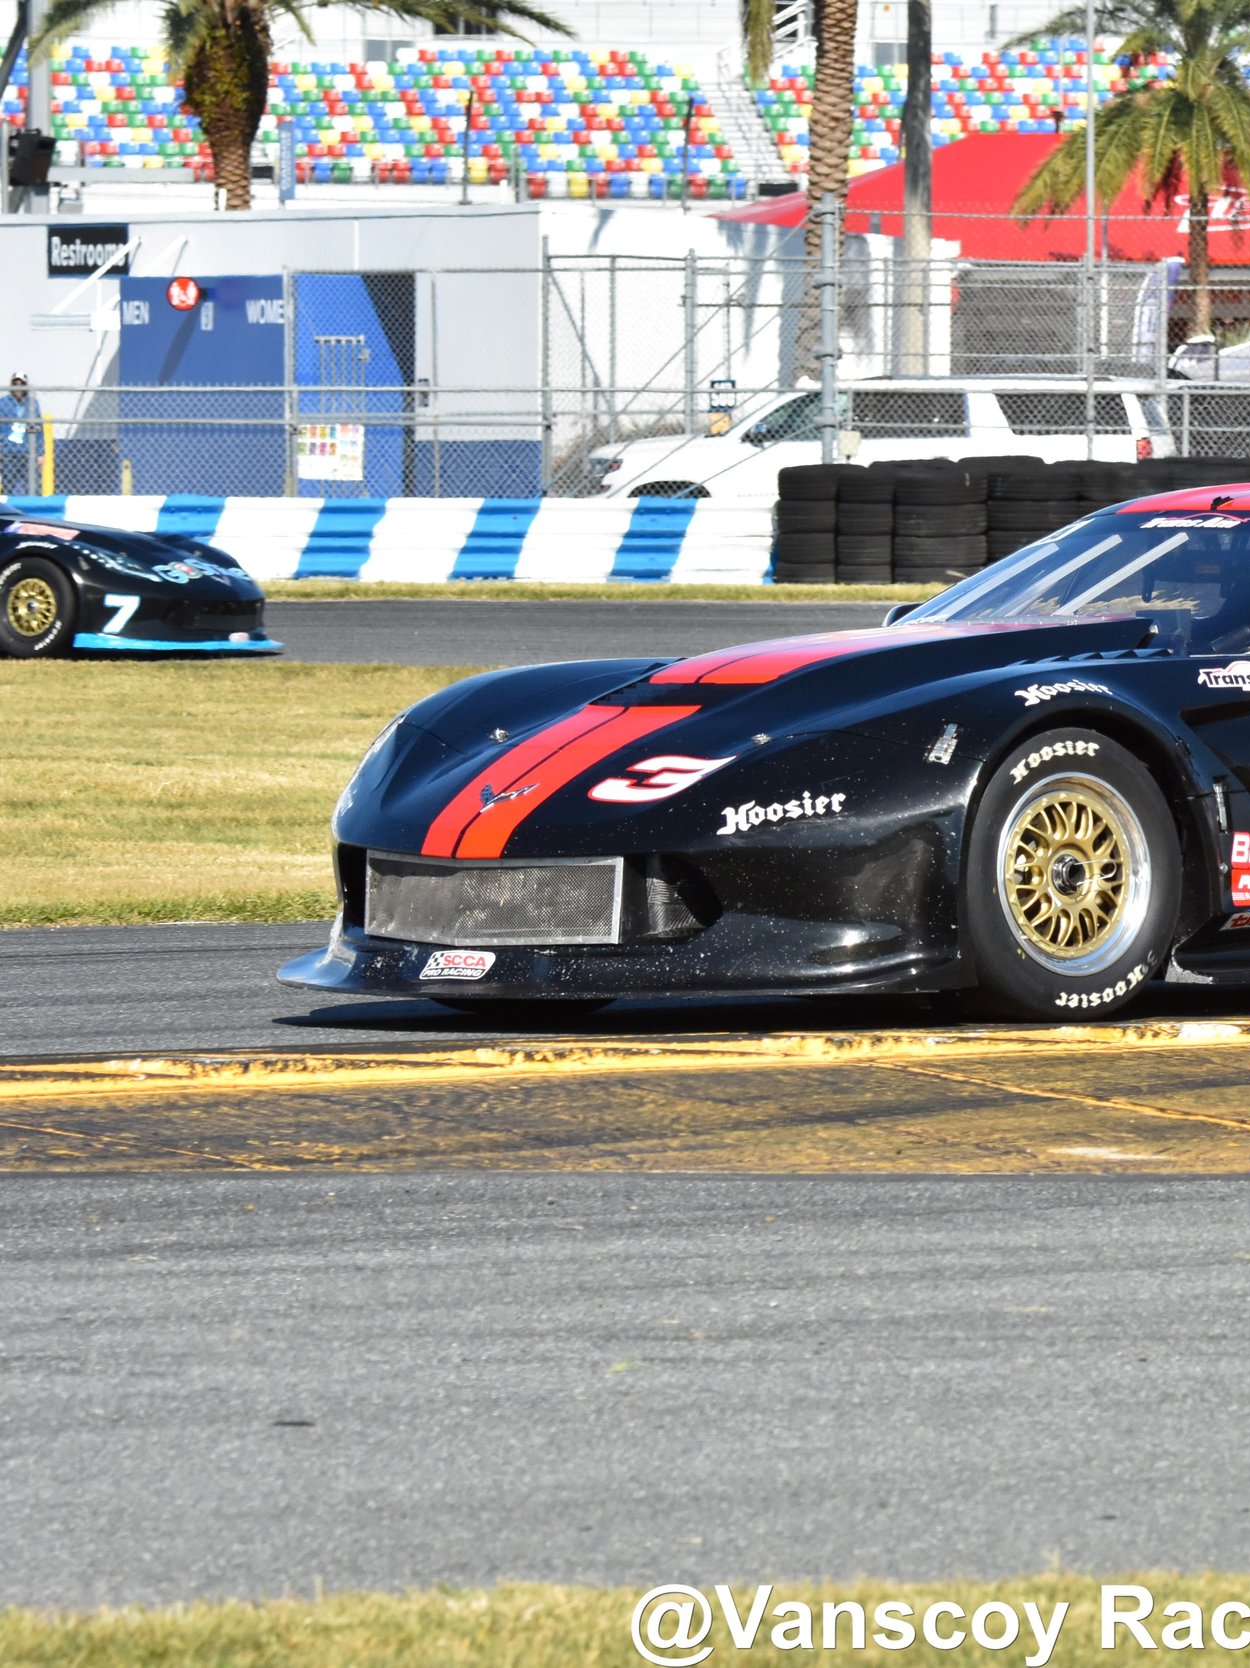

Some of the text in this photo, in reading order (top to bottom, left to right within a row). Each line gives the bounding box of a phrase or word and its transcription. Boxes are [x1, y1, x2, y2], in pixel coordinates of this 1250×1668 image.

[50, 236, 126, 266] Restrooms
[122, 301, 149, 324] MEN
[246, 299, 287, 324] WOME
[103, 594, 140, 633] 7
[1014, 679, 1113, 707] Hoosier
[1009, 740, 1100, 785] Hoosier
[587, 755, 738, 804] 3
[716, 791, 847, 836] Hoosier
[422, 968, 483, 977] PRO RACING
[443, 955, 487, 968] SCCA
[1055, 964, 1145, 1008] Hoosier
